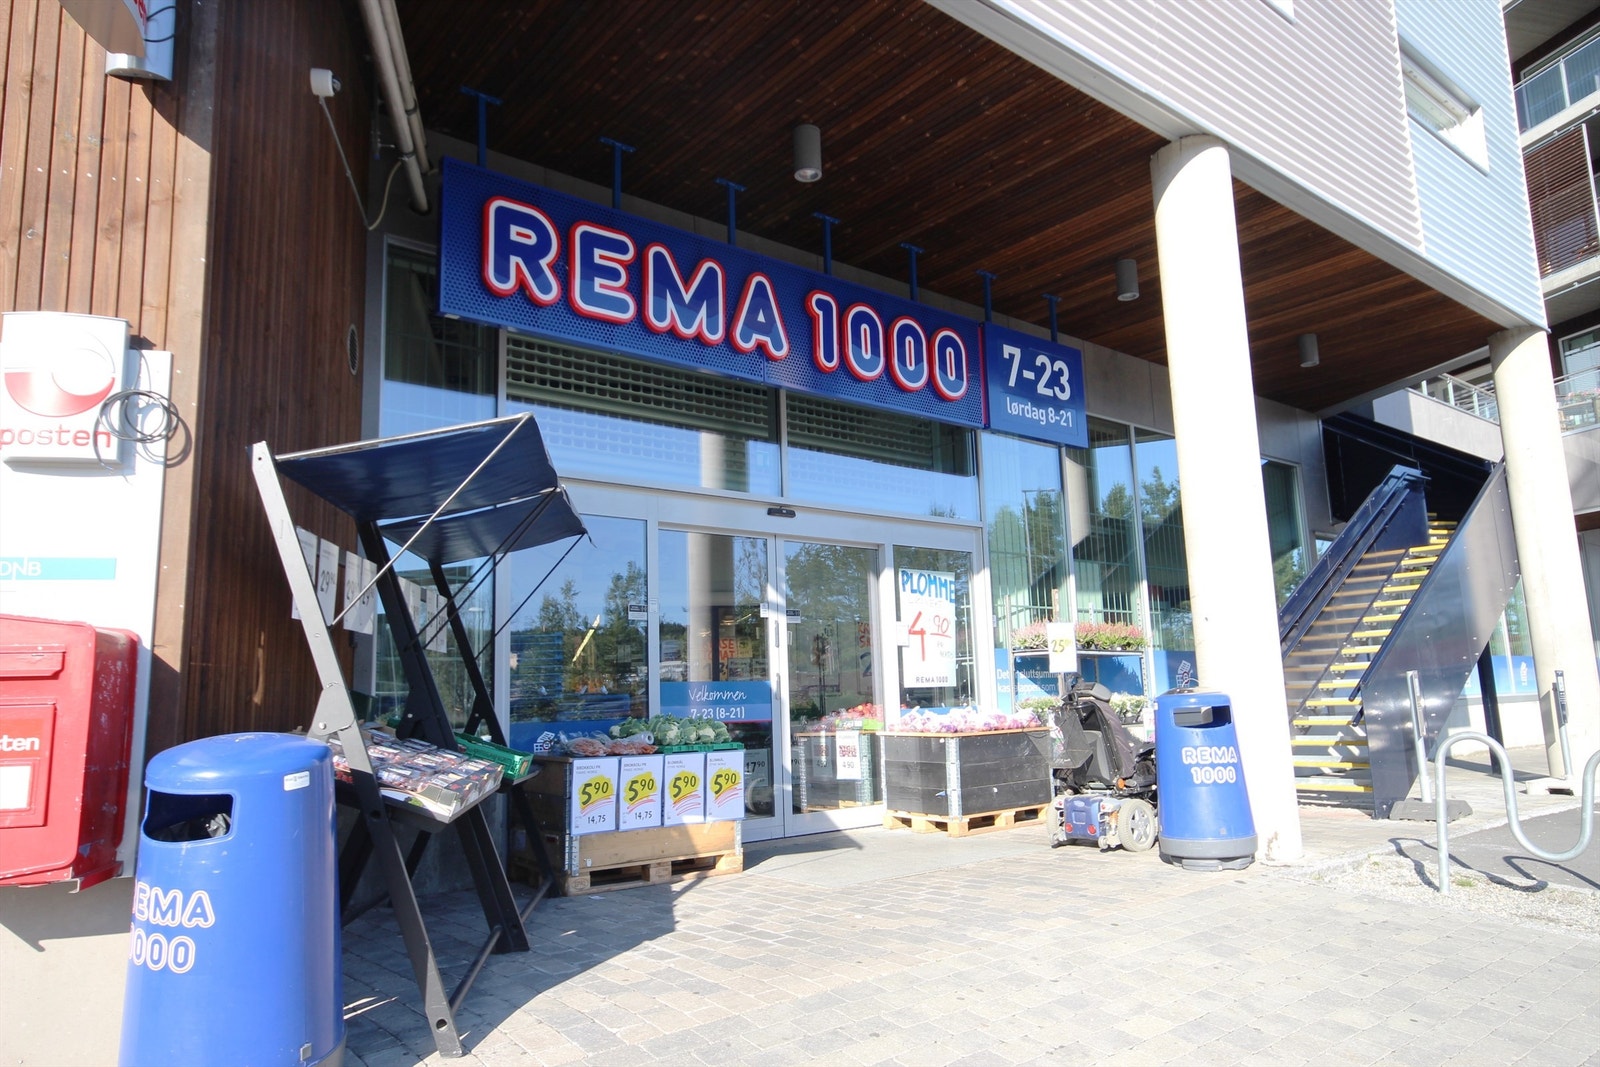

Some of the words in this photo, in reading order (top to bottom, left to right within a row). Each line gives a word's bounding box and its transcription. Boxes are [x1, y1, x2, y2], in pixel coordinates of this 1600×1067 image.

[482, 196, 790, 360] REMA
[806, 289, 968, 402] 1000
[1003, 344, 1071, 401] 7-23
[1007, 396, 1046, 425] lørdag
[1048, 407, 1072, 428] 8-21
[0, 424, 111, 449] posten
[0, 557, 42, 582] DNB
[901, 570, 955, 603] PLOMME
[916, 676, 934, 684] REMA
[689, 685, 747, 701] Velkommen
[716, 706, 745, 719] (8-21)
[1181, 746, 1238, 764] REMA
[1191, 766, 1237, 784] 1000
[587, 814, 606, 825] 14,75
[635, 810, 653, 820] 14,75
[132, 879, 216, 929] EMA
